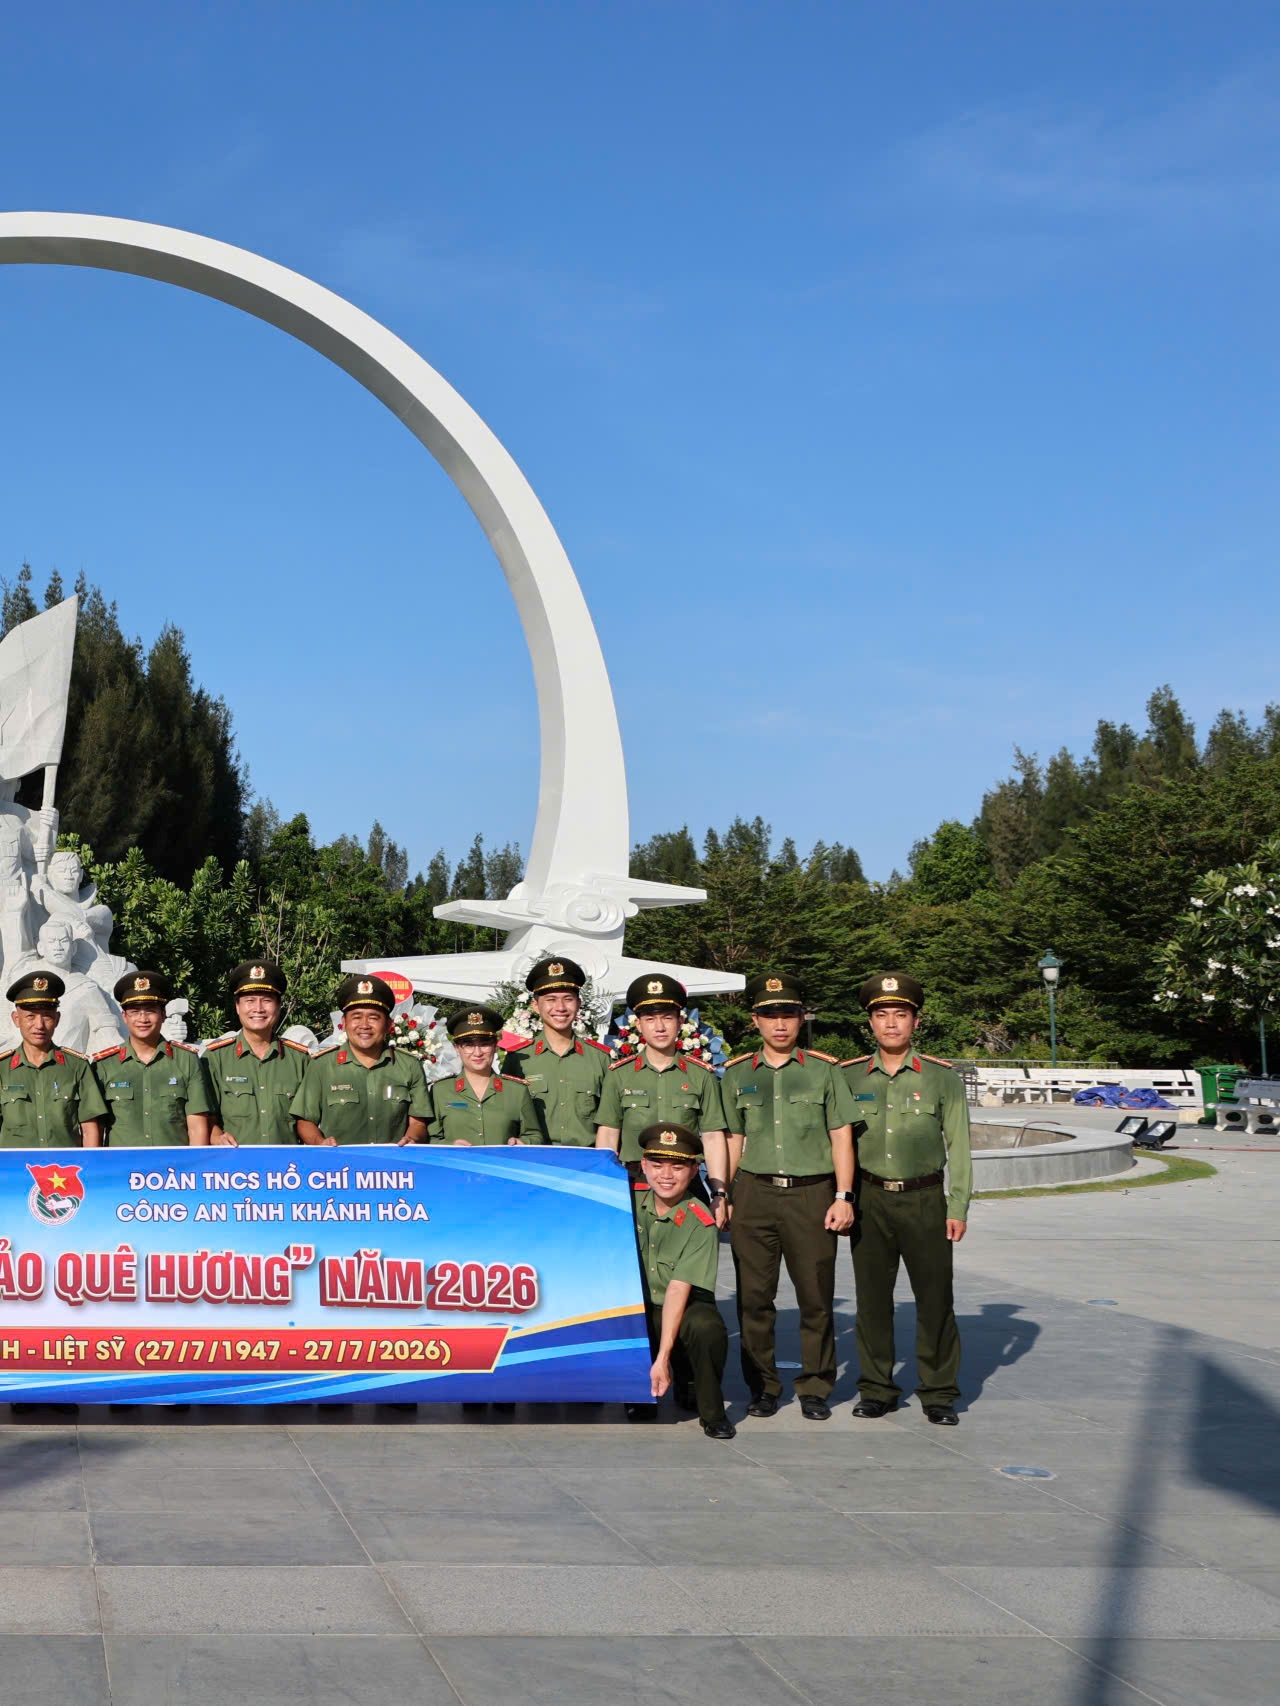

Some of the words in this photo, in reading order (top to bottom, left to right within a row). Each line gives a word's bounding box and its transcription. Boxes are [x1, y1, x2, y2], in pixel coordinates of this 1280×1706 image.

[128, 1167, 196, 1191] ĐOÀN
[202, 1171, 260, 1190] TNCS
[266, 1162, 301, 1190] HỒ
[308, 1166, 349, 1190] CHÍ
[355, 1170, 414, 1190] MINH
[116, 1199, 188, 1222] CÔNG
[194, 1203, 227, 1221] AN
[232, 1197, 284, 1221] TỈNH
[291, 1198, 371, 1222] KHÁNH
[377, 1198, 430, 1222] HÒA
[54, 1243, 138, 1306] QUÊ
[319, 1248, 425, 1309] NĂM
[426, 1260, 539, 1314] 2026
[43, 1335, 89, 1366] LIỆT
[95, 1336, 126, 1361] SỸ
[134, 1340, 280, 1366] (27/7/1947
[303, 1340, 452, 1366] 27/7/2026)
